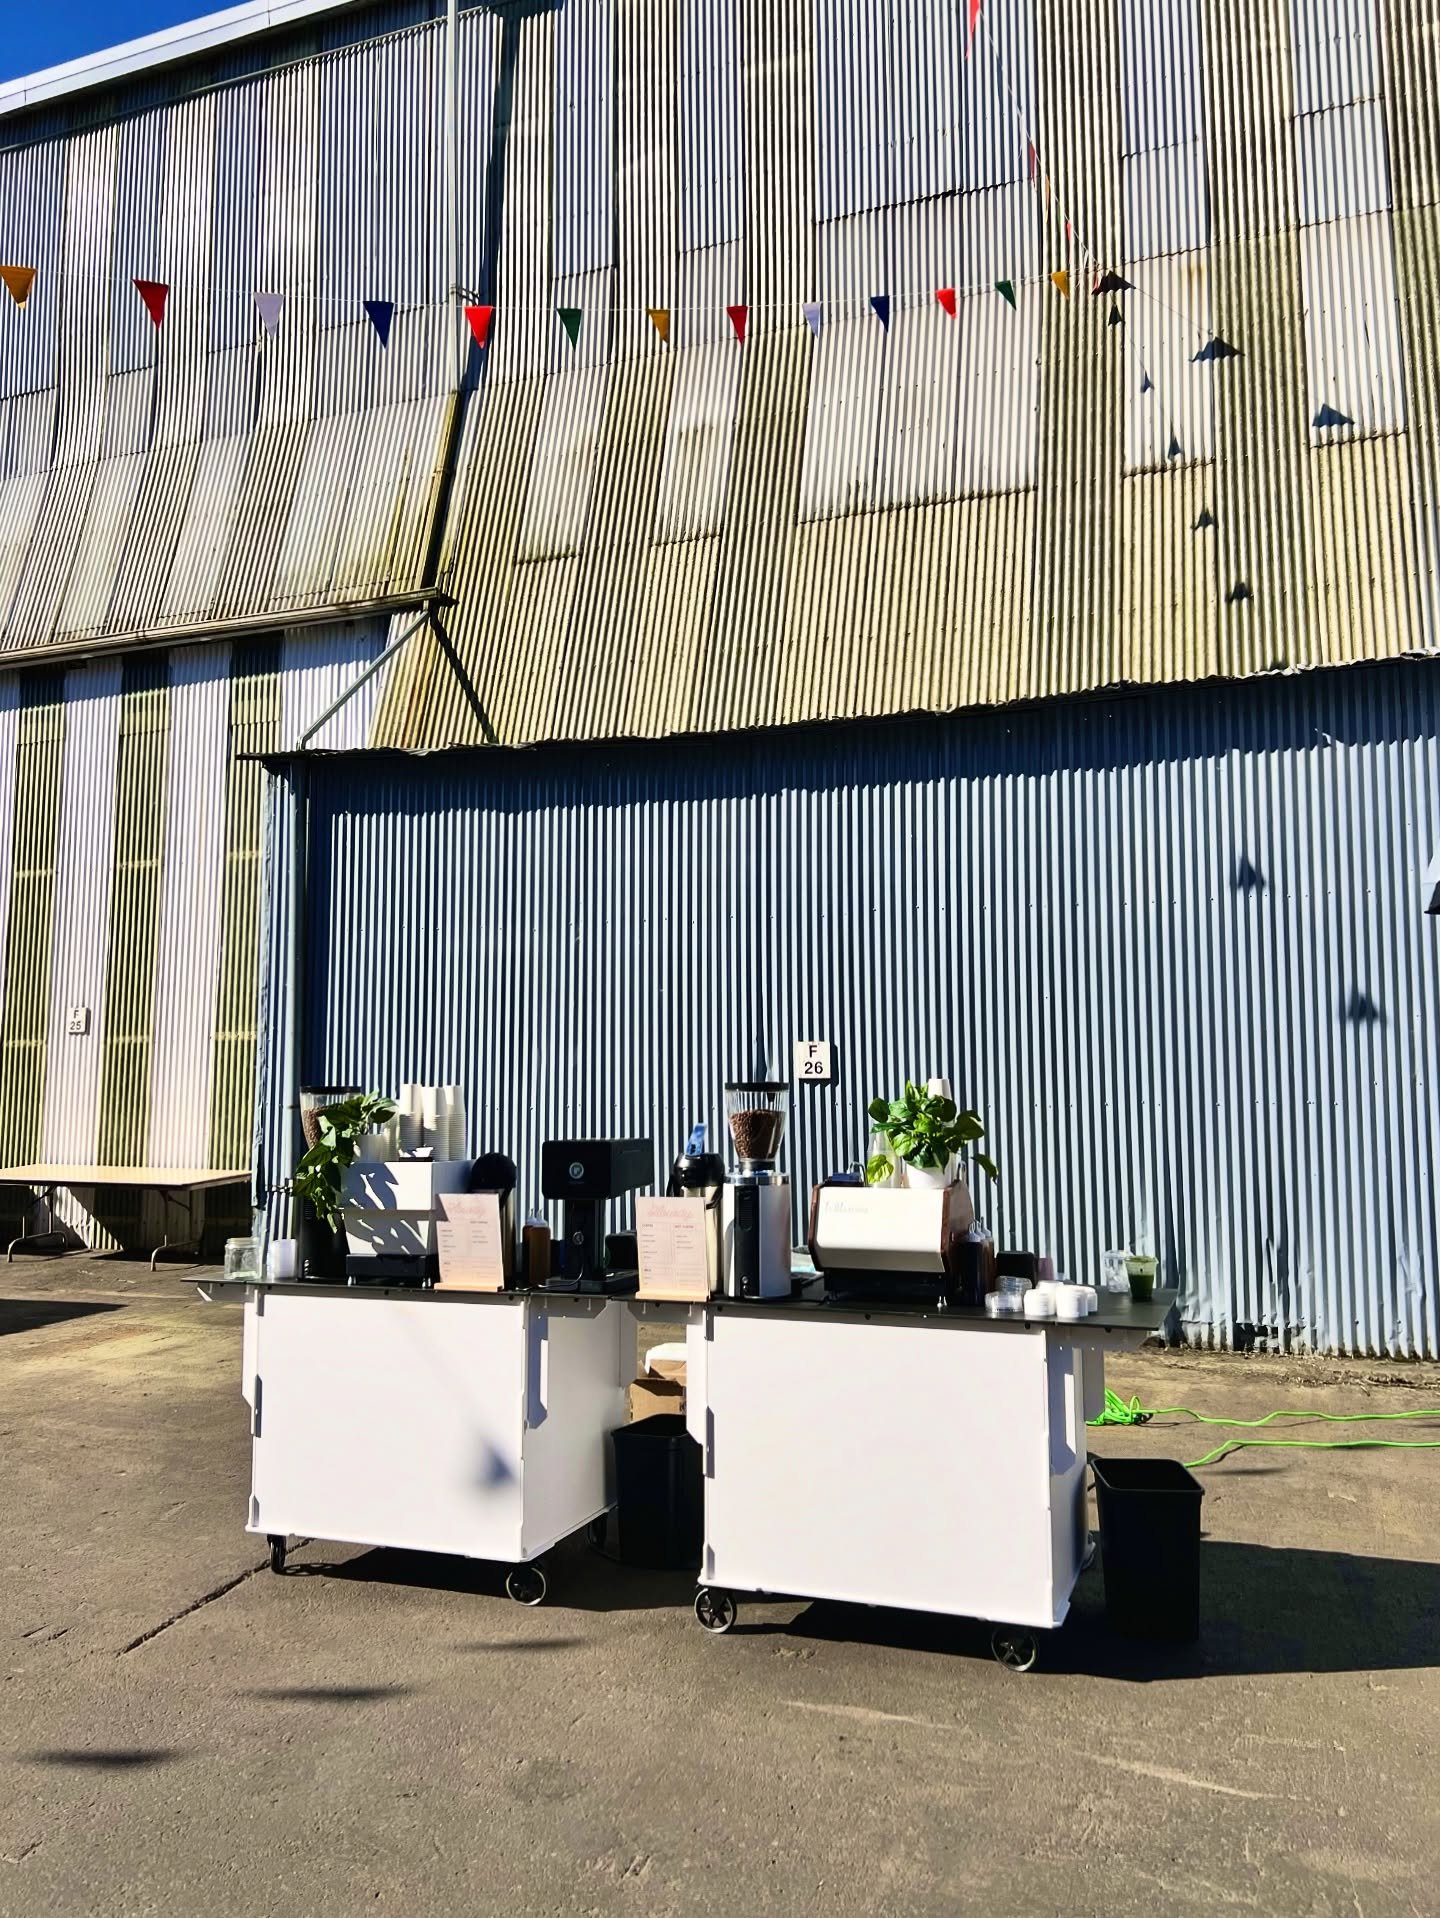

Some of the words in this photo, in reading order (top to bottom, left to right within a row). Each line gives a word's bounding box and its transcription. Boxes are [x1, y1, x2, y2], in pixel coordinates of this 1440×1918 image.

[70, 1021, 81, 1030] 25
[809, 1045, 817, 1058] F
[804, 1061, 823, 1074] 26
